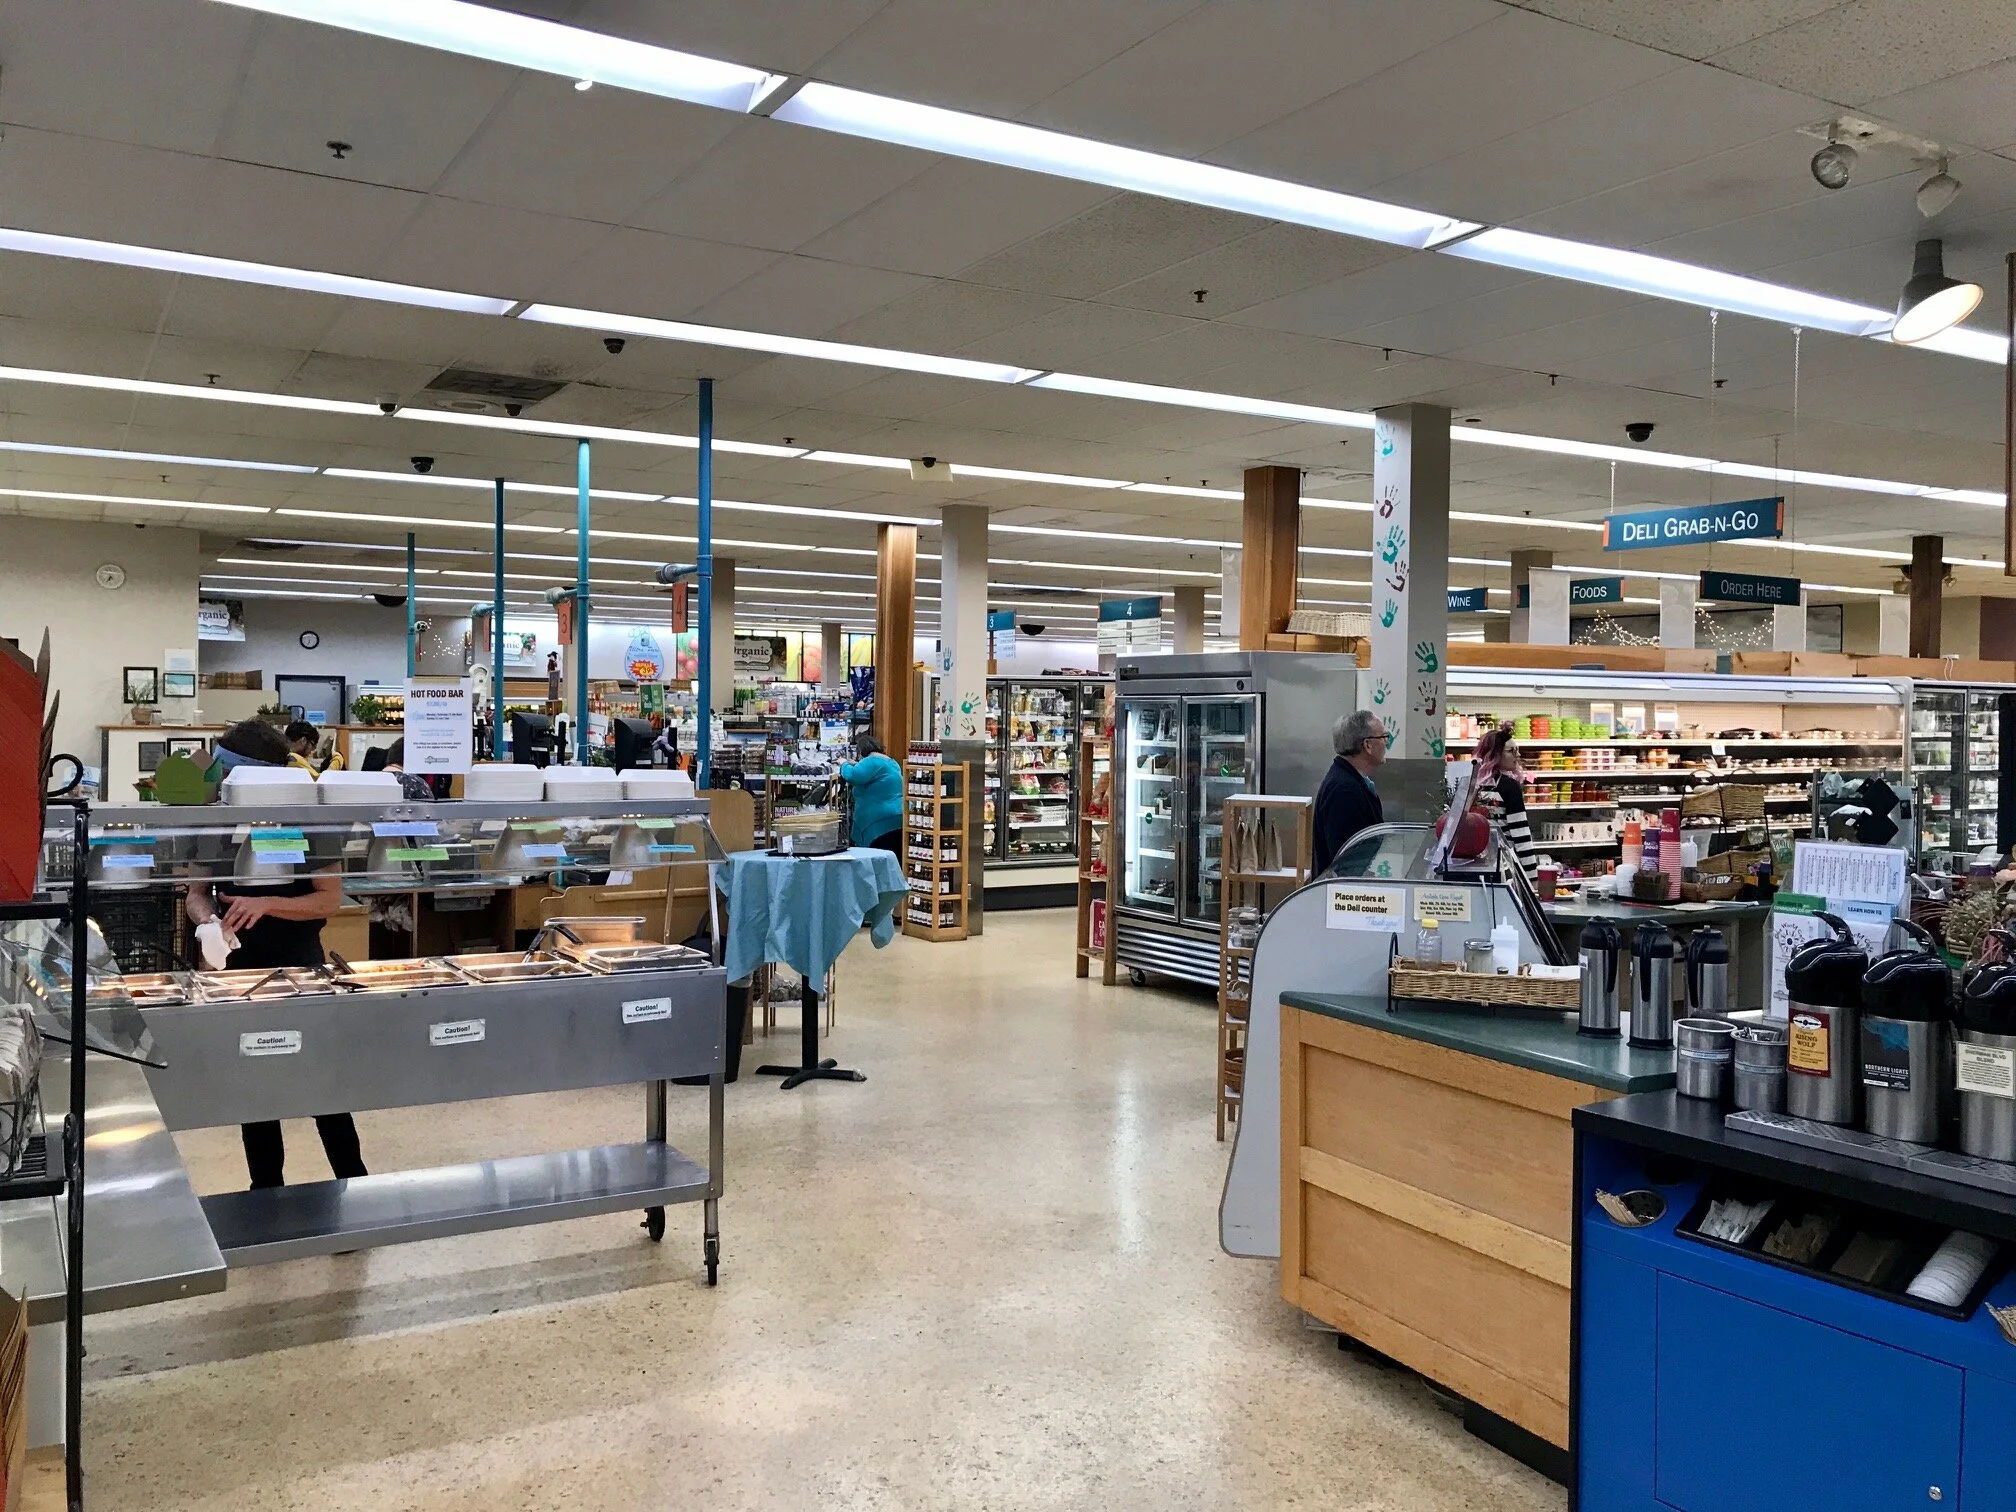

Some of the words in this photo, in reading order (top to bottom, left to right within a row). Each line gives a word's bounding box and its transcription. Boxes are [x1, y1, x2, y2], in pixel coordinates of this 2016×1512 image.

[1572, 586, 1607, 599] FOODS
[1721, 579, 1753, 596] ORDER
[1757, 582, 1782, 598] HERE
[199, 609, 227, 621] rganic
[1126, 605, 1132, 616] 4
[562, 613, 568, 634] 3
[989, 618, 994, 628] 3
[411, 690, 425, 698] HOT
[427, 690, 446, 698] FOOD
[448, 690, 464, 698] BAR
[1334, 892, 1354, 901] Place
[1355, 893, 1376, 902] orders
[1377, 895, 1385, 903] at
[1334, 903, 1345, 911] the
[1347, 904, 1360, 912] Deli
[1361, 905, 1388, 914] counter
[635, 1004, 659, 1012] Caution!
[445, 1025, 471, 1034] Caution!
[257, 1036, 286, 1045] Caution!
